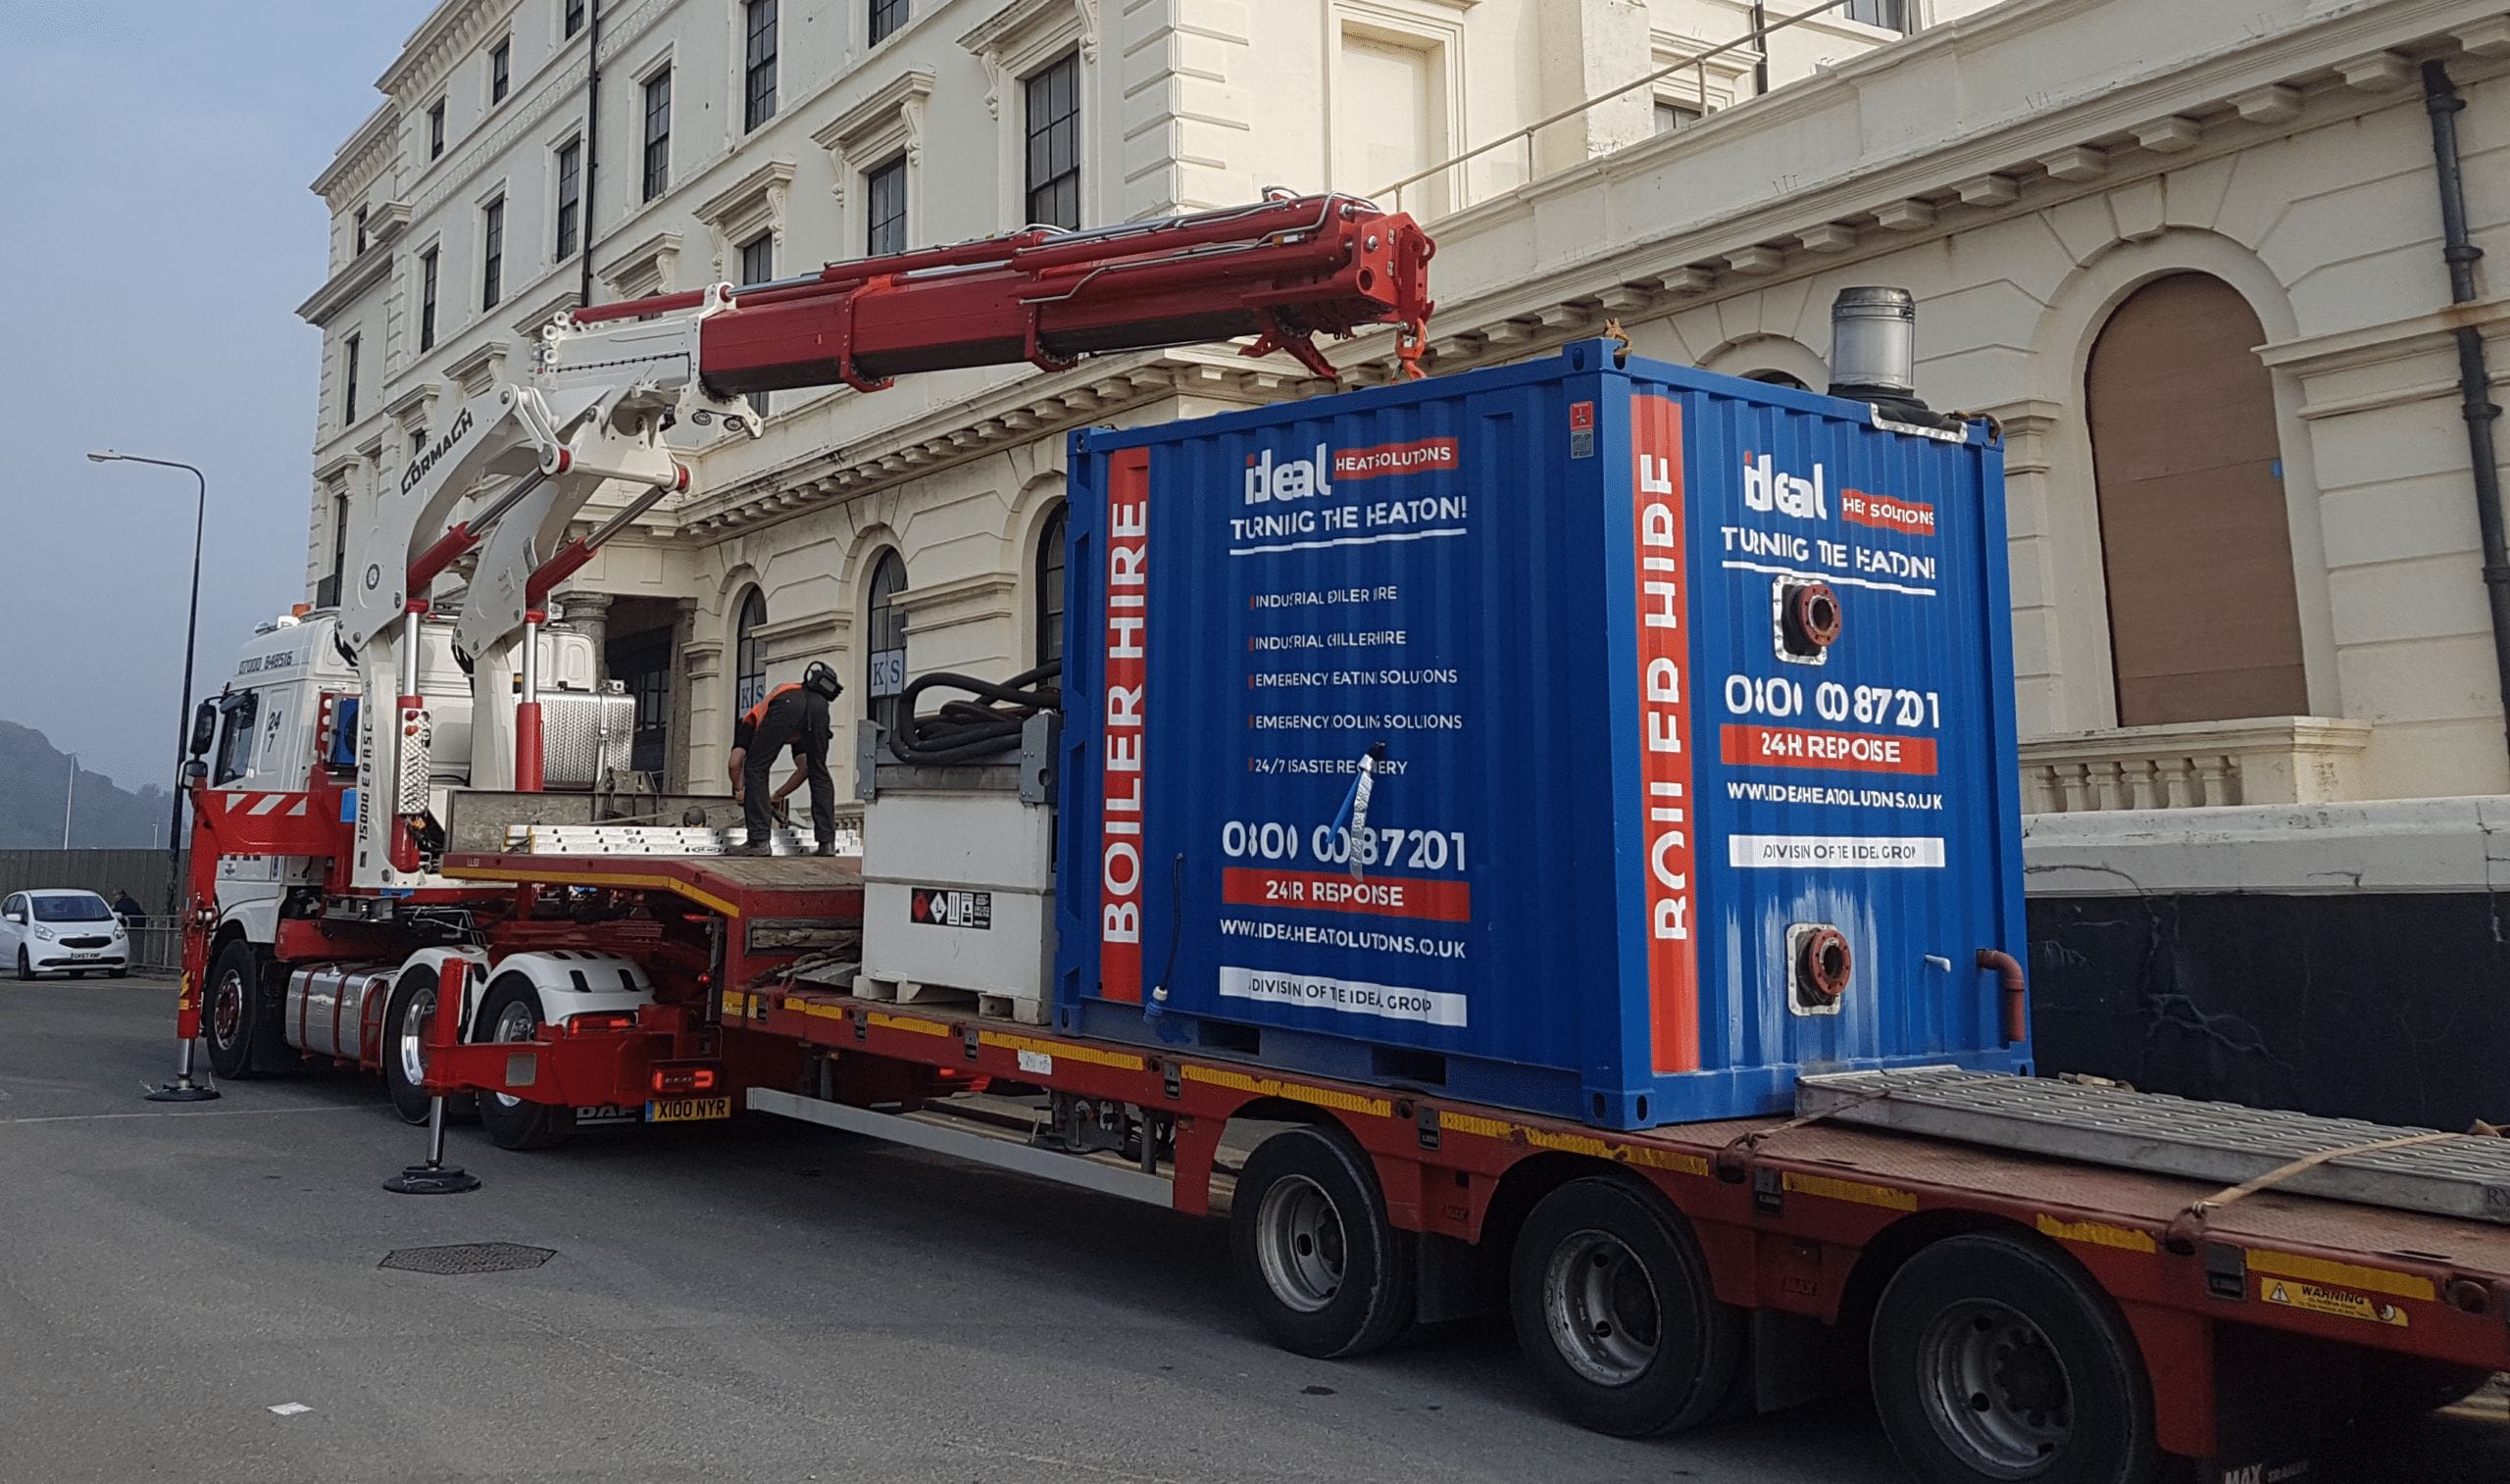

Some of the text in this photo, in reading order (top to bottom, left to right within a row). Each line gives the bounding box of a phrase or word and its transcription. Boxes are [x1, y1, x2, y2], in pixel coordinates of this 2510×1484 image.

[401, 407, 474, 496] CORMACH
[1245, 442, 1331, 505] ideal
[1744, 451, 1828, 520] ideal
[1109, 500, 1147, 660] HIRE
[268, 711, 282, 731] 24
[268, 733, 276, 753] 7
[1255, 758, 1285, 775] 24/7
[1103, 684, 1143, 944] BOILER
[1814, 844, 1835, 859] OF
[1306, 984, 1327, 999] OF
[658, 1099, 726, 1118] X100 NYR
